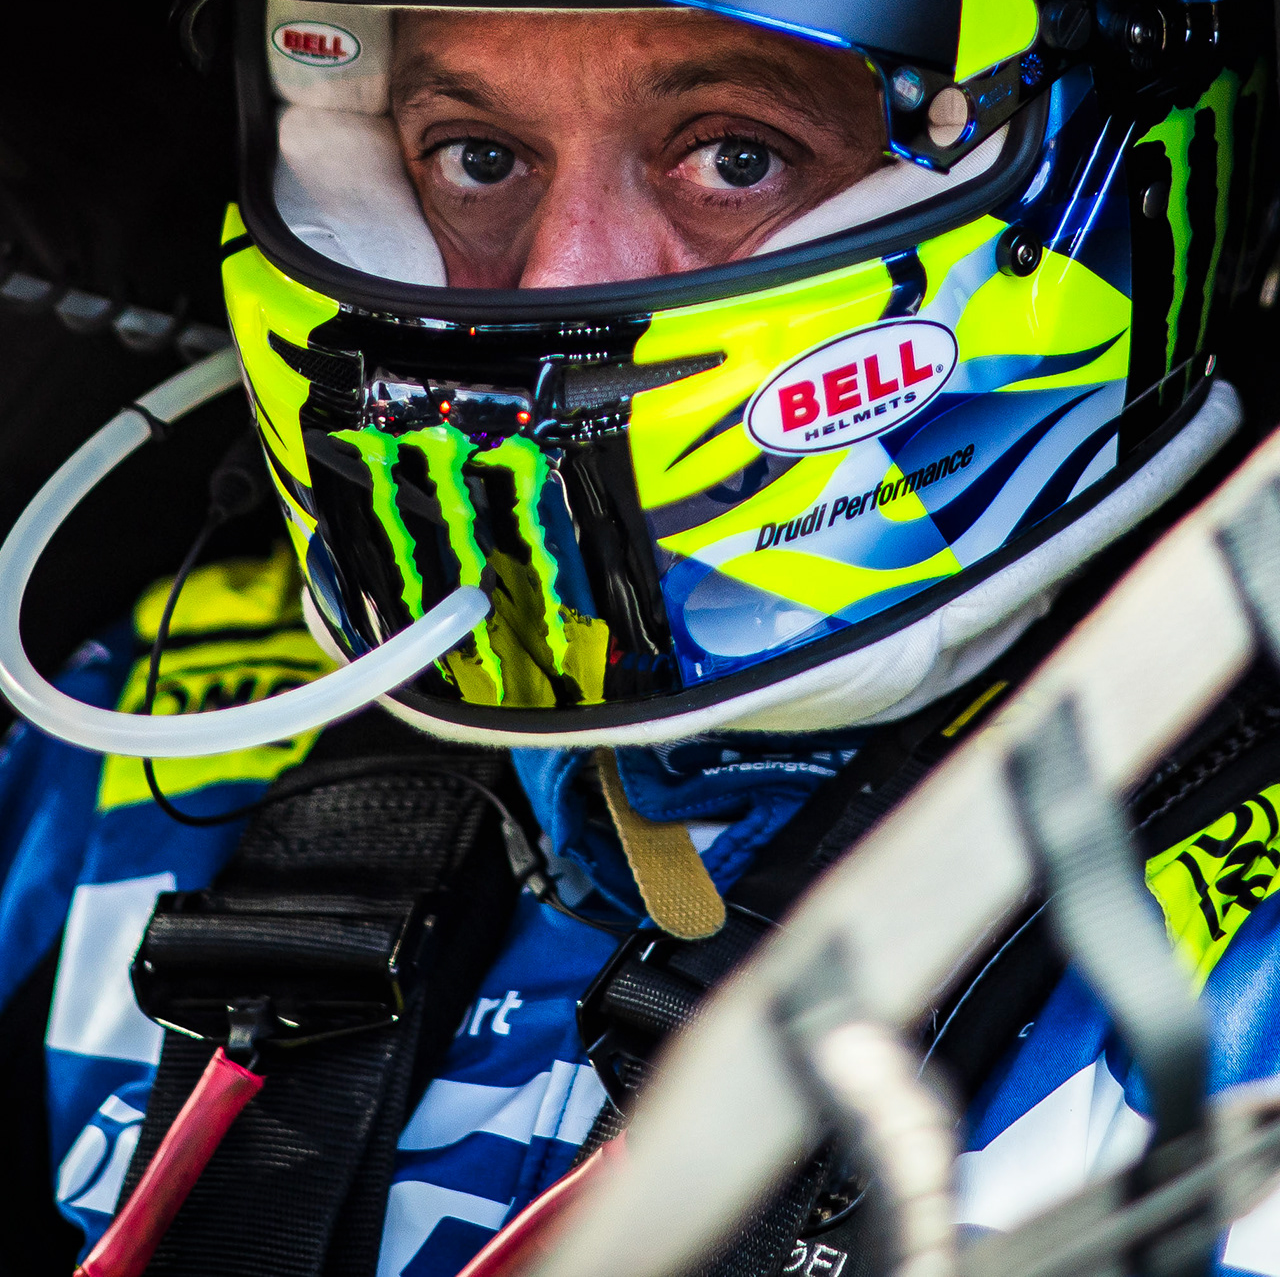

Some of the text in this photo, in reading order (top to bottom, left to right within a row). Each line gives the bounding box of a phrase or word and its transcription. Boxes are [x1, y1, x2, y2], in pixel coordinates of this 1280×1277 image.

[283, 29, 347, 57] BELL
[777, 339, 934, 433] BELL
[804, 391, 918, 442] HELMETS
[755, 443, 975, 552] Drudi Performance
